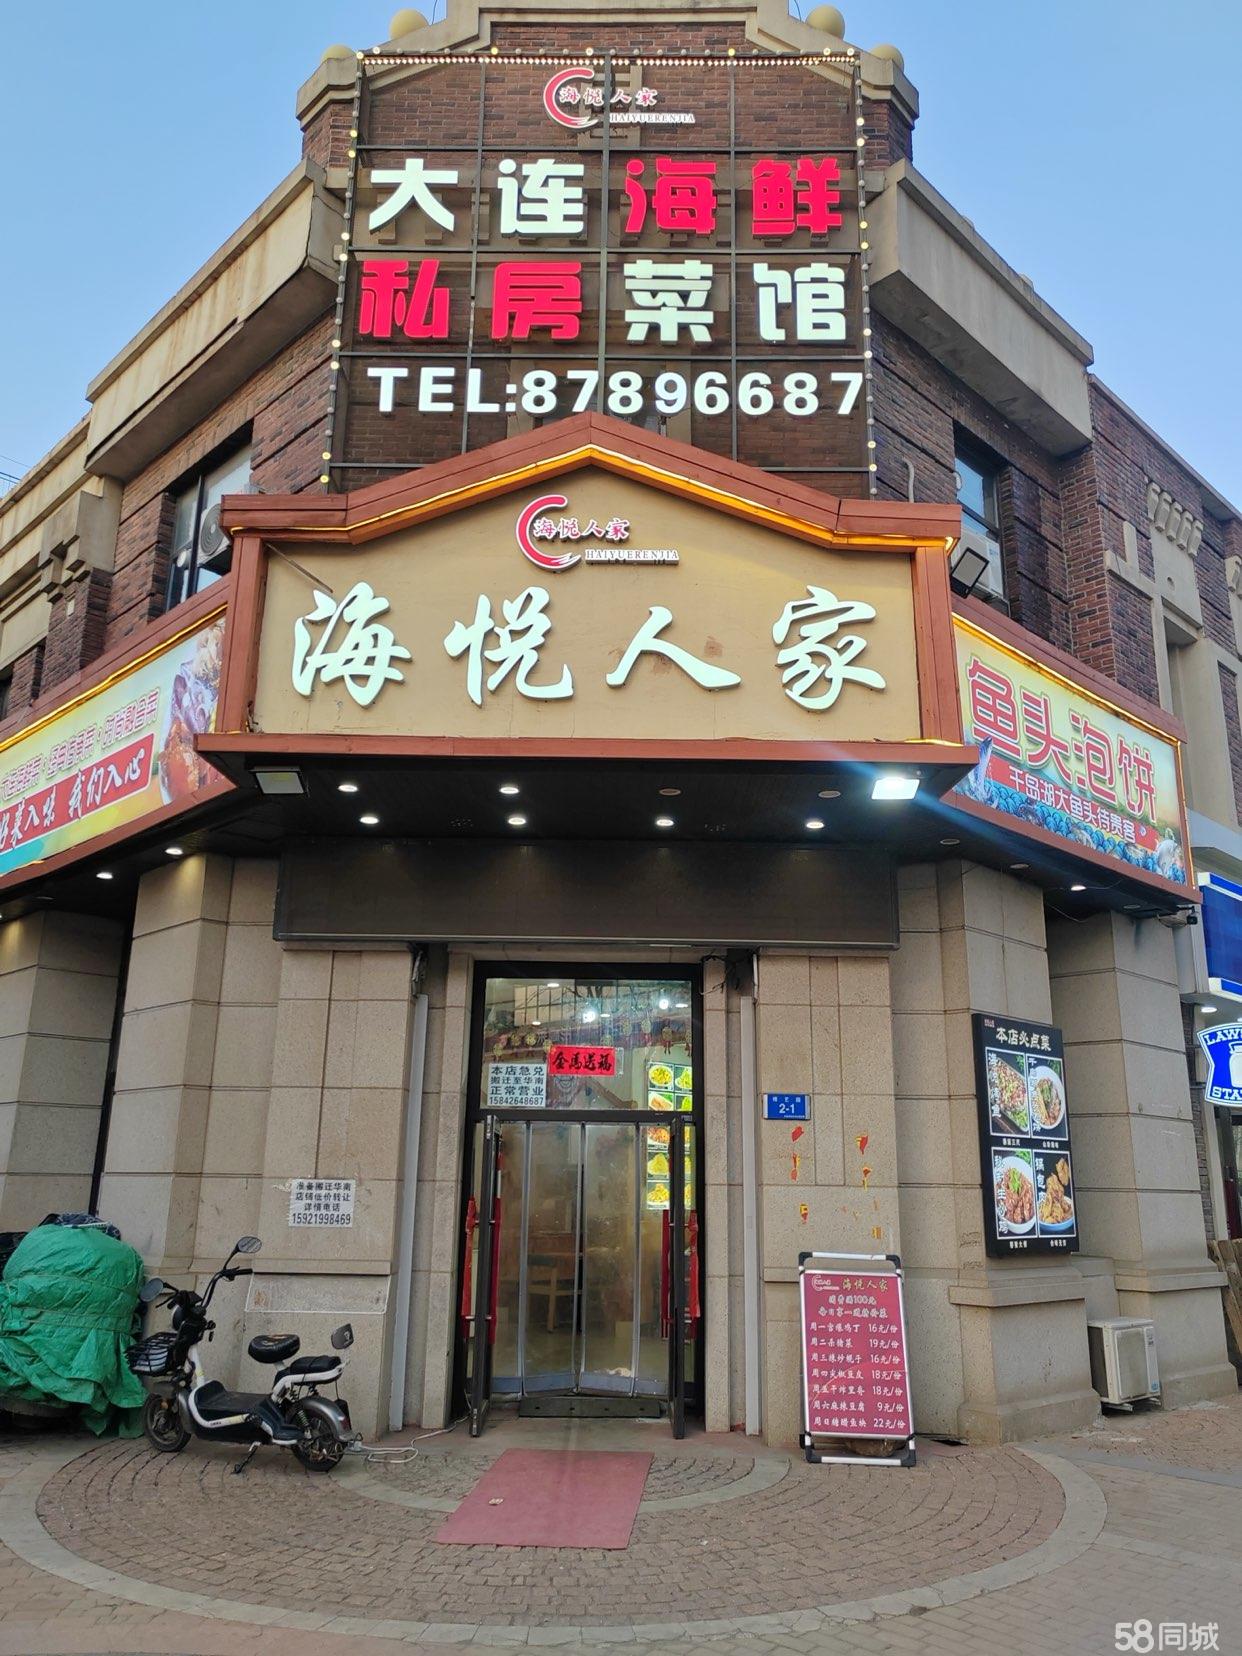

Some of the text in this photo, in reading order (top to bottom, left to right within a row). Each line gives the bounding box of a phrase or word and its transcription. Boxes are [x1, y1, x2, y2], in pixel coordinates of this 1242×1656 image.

[559, 86, 658, 106] 海悦人家
[609, 113, 695, 123] HAIYUERENJIA
[368, 157, 843, 236] 大连海鲜
[358, 259, 847, 344] 私房菜馆
[367, 366, 864, 416] TEL:87896687
[532, 517, 630, 540] 海悦人家
[585, 549, 680, 561] HAIYUERENJIA
[291, 582, 888, 713] 海悦人家
[968, 657, 1157, 824] 鱼头泡饼
[1008, 765, 1136, 844] 千岛湖大鱼头待贵客
[995, 1027, 1052, 1052] 本店必点菜
[1204, 1028, 1242, 1046] LAW
[491, 1066, 544, 1076] 本店急兑
[490, 1076, 544, 1085] 搬迁至华南
[490, 1086, 544, 1096] 正常营业
[1212, 1086, 1242, 1101] STA
[779, 1103, 795, 1114] 2-1
[304, 1203, 341, 1212] 详情电话
[292, 1213, 351, 1225] 15921998469
[842, 1278, 889, 1292] 海悦人家
